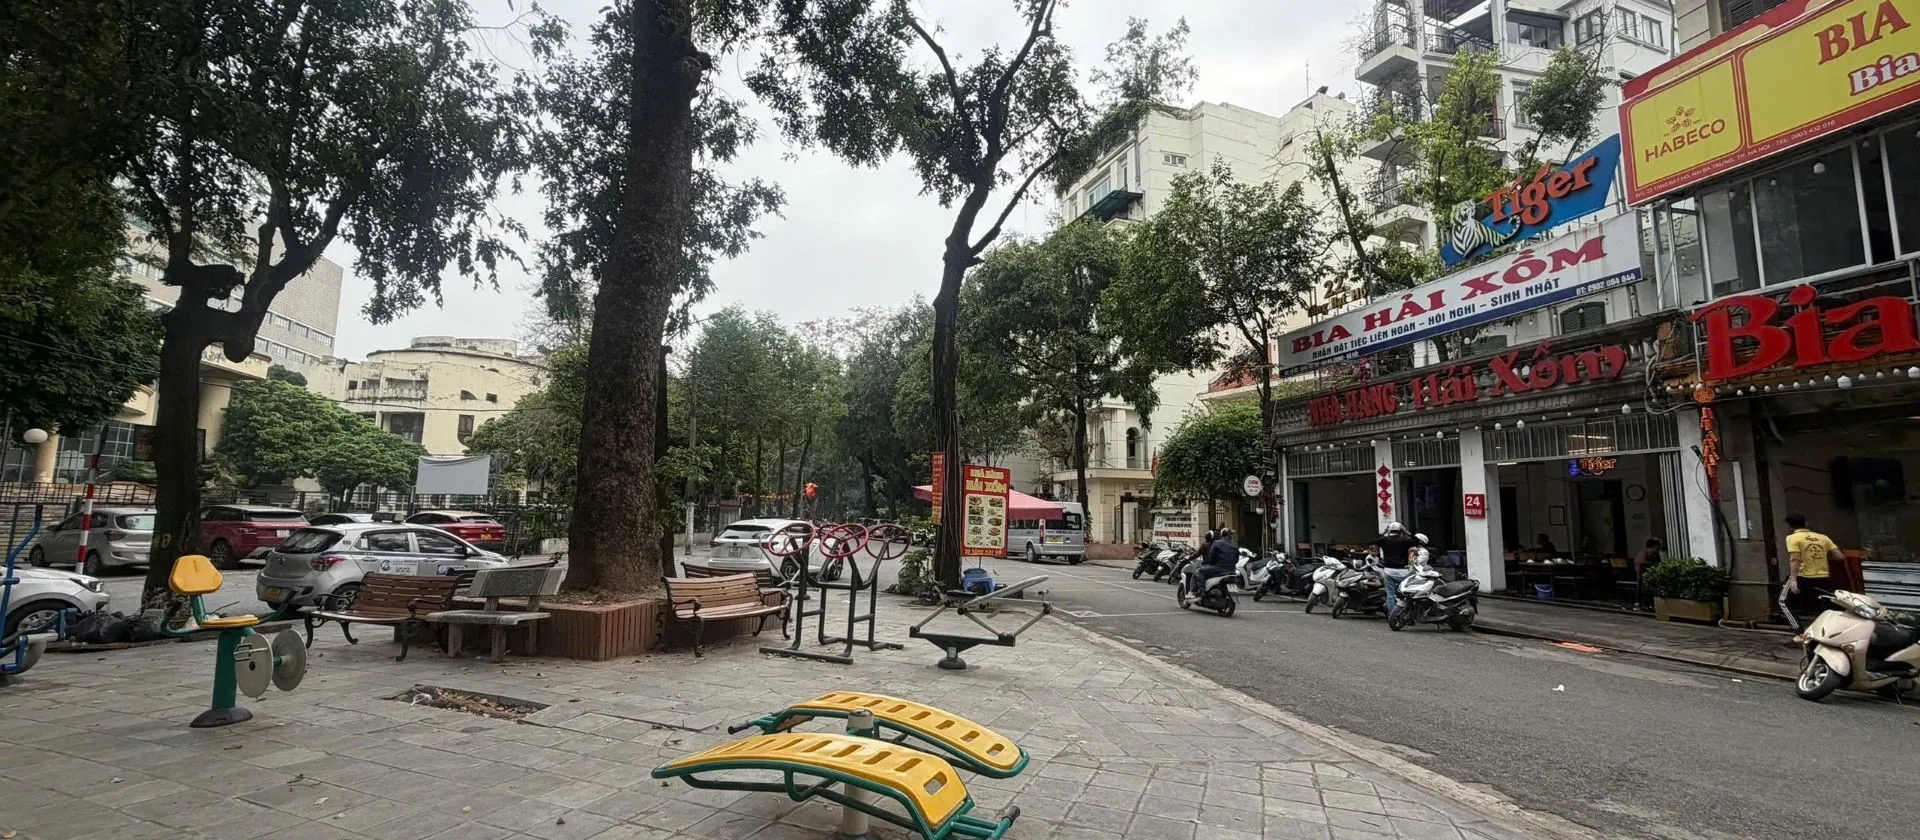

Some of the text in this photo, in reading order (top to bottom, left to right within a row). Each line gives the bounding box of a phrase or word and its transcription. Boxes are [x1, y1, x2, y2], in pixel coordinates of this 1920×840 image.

[1815, 0, 1911, 65] BIA
[1849, 52, 1920, 96] Bia
[1645, 118, 1725, 162] HABECO
[1486, 156, 1597, 225] Tiger
[1291, 235, 1608, 355] BIA HẢI XỒM
[1324, 273, 1346, 299] 22
[1369, 329, 1388, 344] LIÊN
[1391, 321, 1416, 336] HOAN
[1490, 289, 1520, 307] SINH
[1525, 277, 1560, 298] NHẬT
[1688, 283, 1920, 380] Bia
[1308, 339, 1629, 426] NHÀ HÀNG Hải Xồm
[1466, 495, 1481, 507] 24
